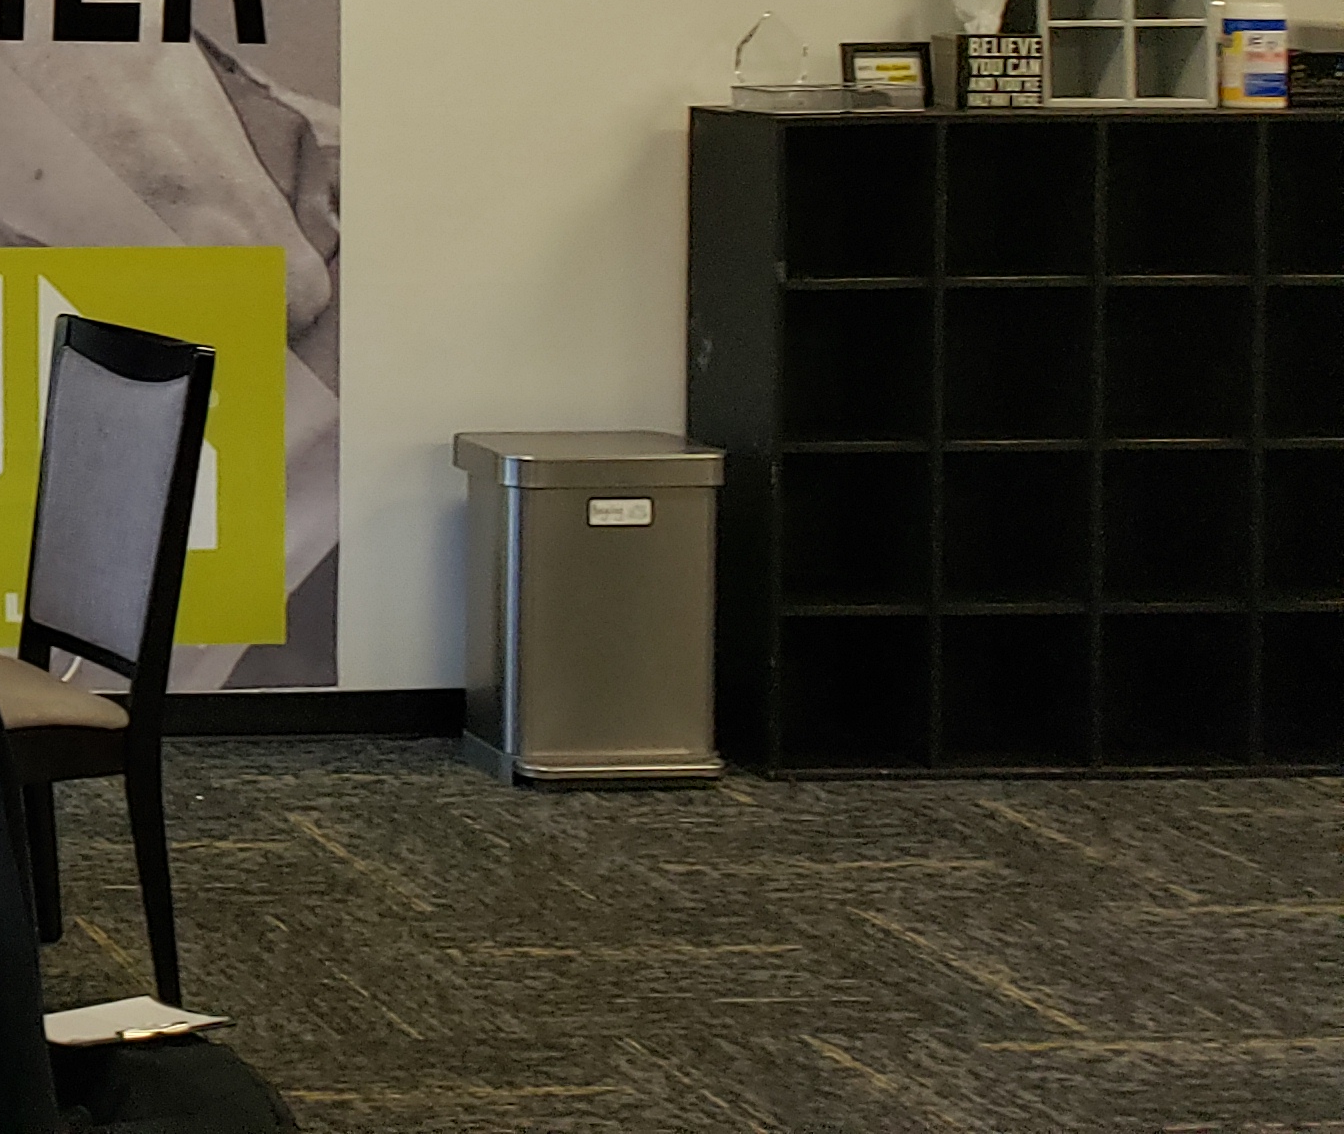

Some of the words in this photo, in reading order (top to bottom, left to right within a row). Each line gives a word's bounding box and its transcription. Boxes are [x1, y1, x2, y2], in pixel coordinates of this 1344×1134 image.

[968, 37, 1043, 56] BELIEVE
[969, 58, 1003, 75] YOU
[1006, 58, 1042, 76] CAN
